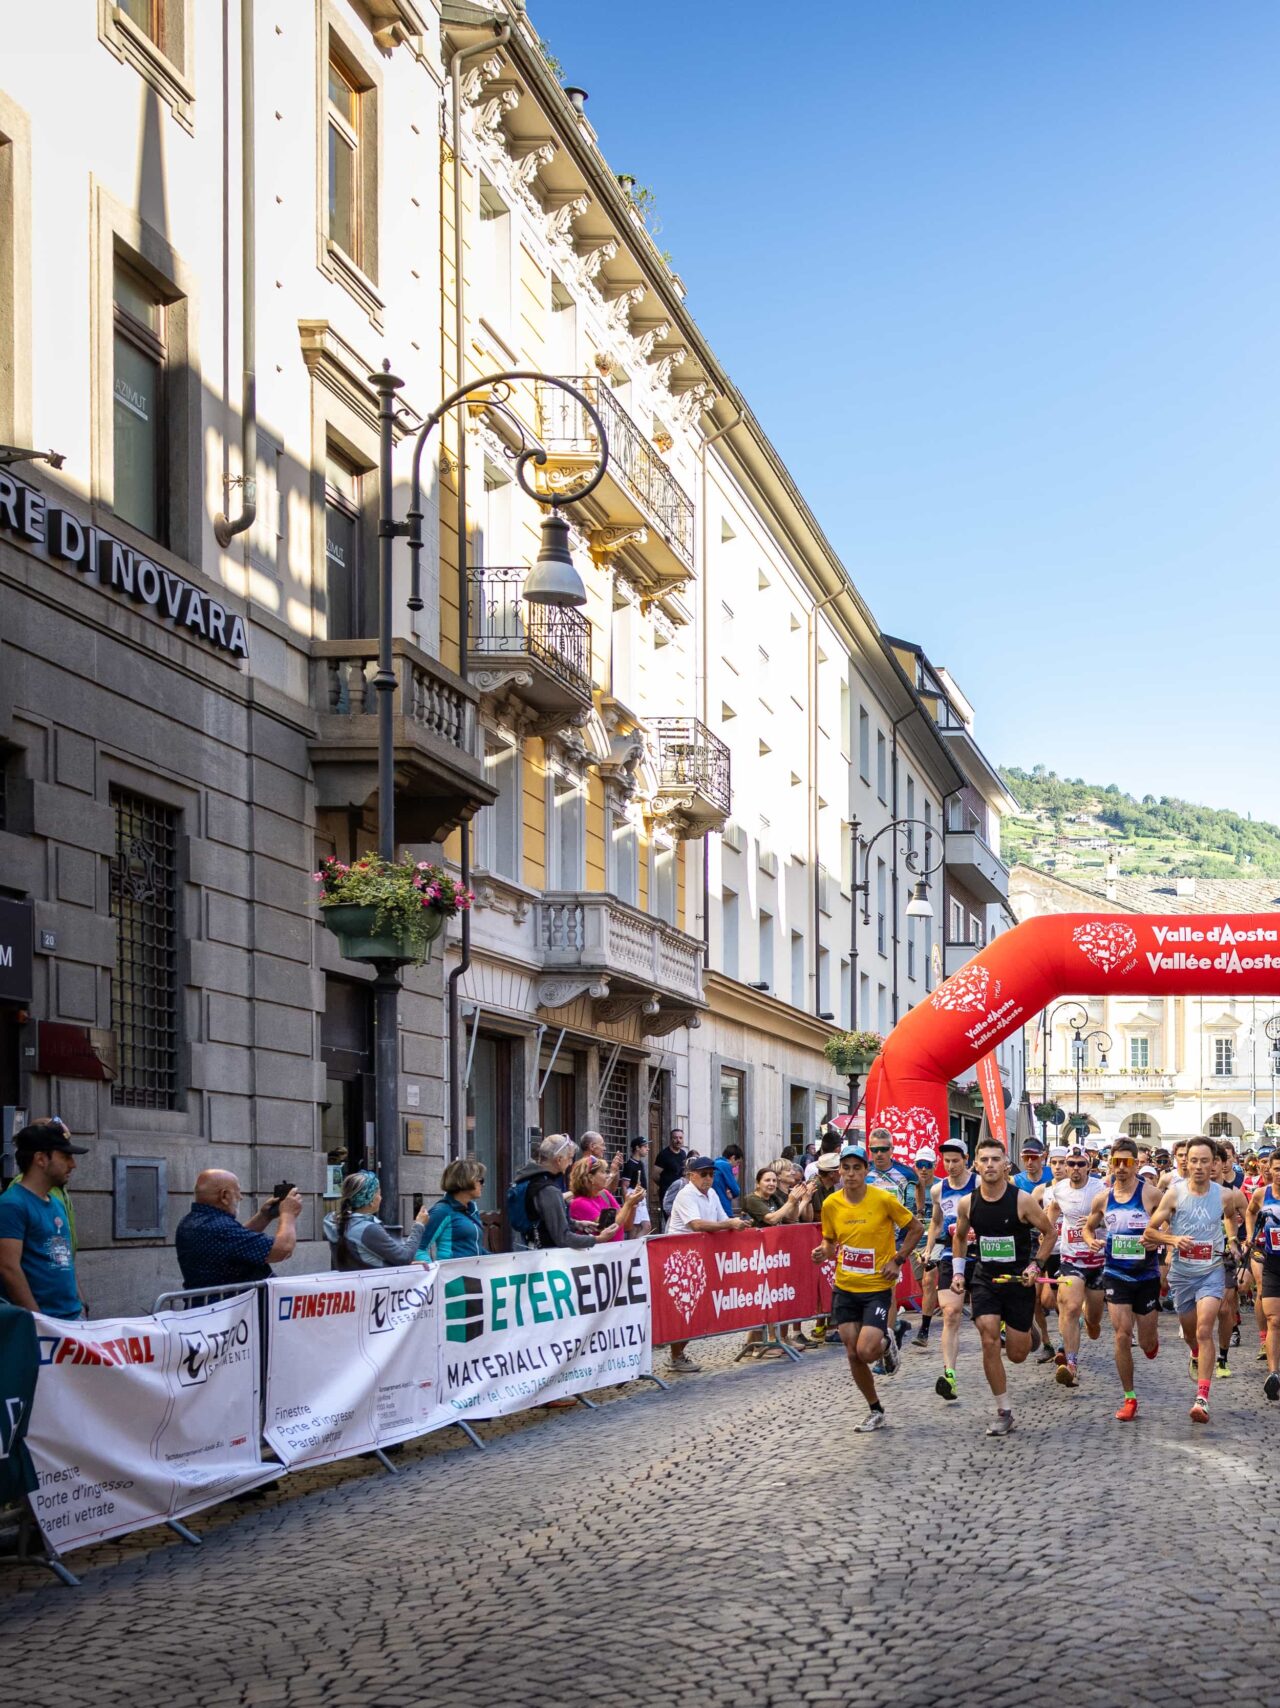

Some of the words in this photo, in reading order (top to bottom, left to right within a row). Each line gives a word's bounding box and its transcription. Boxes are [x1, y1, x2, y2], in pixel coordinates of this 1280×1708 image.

[114, 378, 147, 412] AZIMUT
[56, 507, 98, 573] DI
[108, 538, 249, 659] NOVARA
[44, 934, 55, 947] 20
[1152, 926, 1204, 947] Valle
[1206, 923, 1278, 945] d'Aosta
[1146, 952, 1211, 975] Vallée
[965, 1021, 988, 1040] Valle
[982, 1242, 1001, 1251] 1079
[1114, 1240, 1132, 1248] 1014
[715, 1251, 749, 1281] Valle
[749, 1241, 791, 1275] d'Aosta
[844, 1251, 860, 1262] 237
[291, 1290, 356, 1319] FINSTRAL
[490, 1257, 648, 1332] ETEREDILE
[712, 1286, 754, 1319] Vallée
[754, 1277, 796, 1310] d'Aoste
[446, 1345, 549, 1390] MATERIALI
[450, 1393, 481, 1410] Quart
[487, 1388, 504, 1403] tel.
[607, 1353, 642, 1371] 0166.50
[274, 1403, 313, 1421] Finestre
[276, 1422, 310, 1439] Porte
[36, 1491, 69, 1511] Porte
[75, 1500, 116, 1525] vetrate
